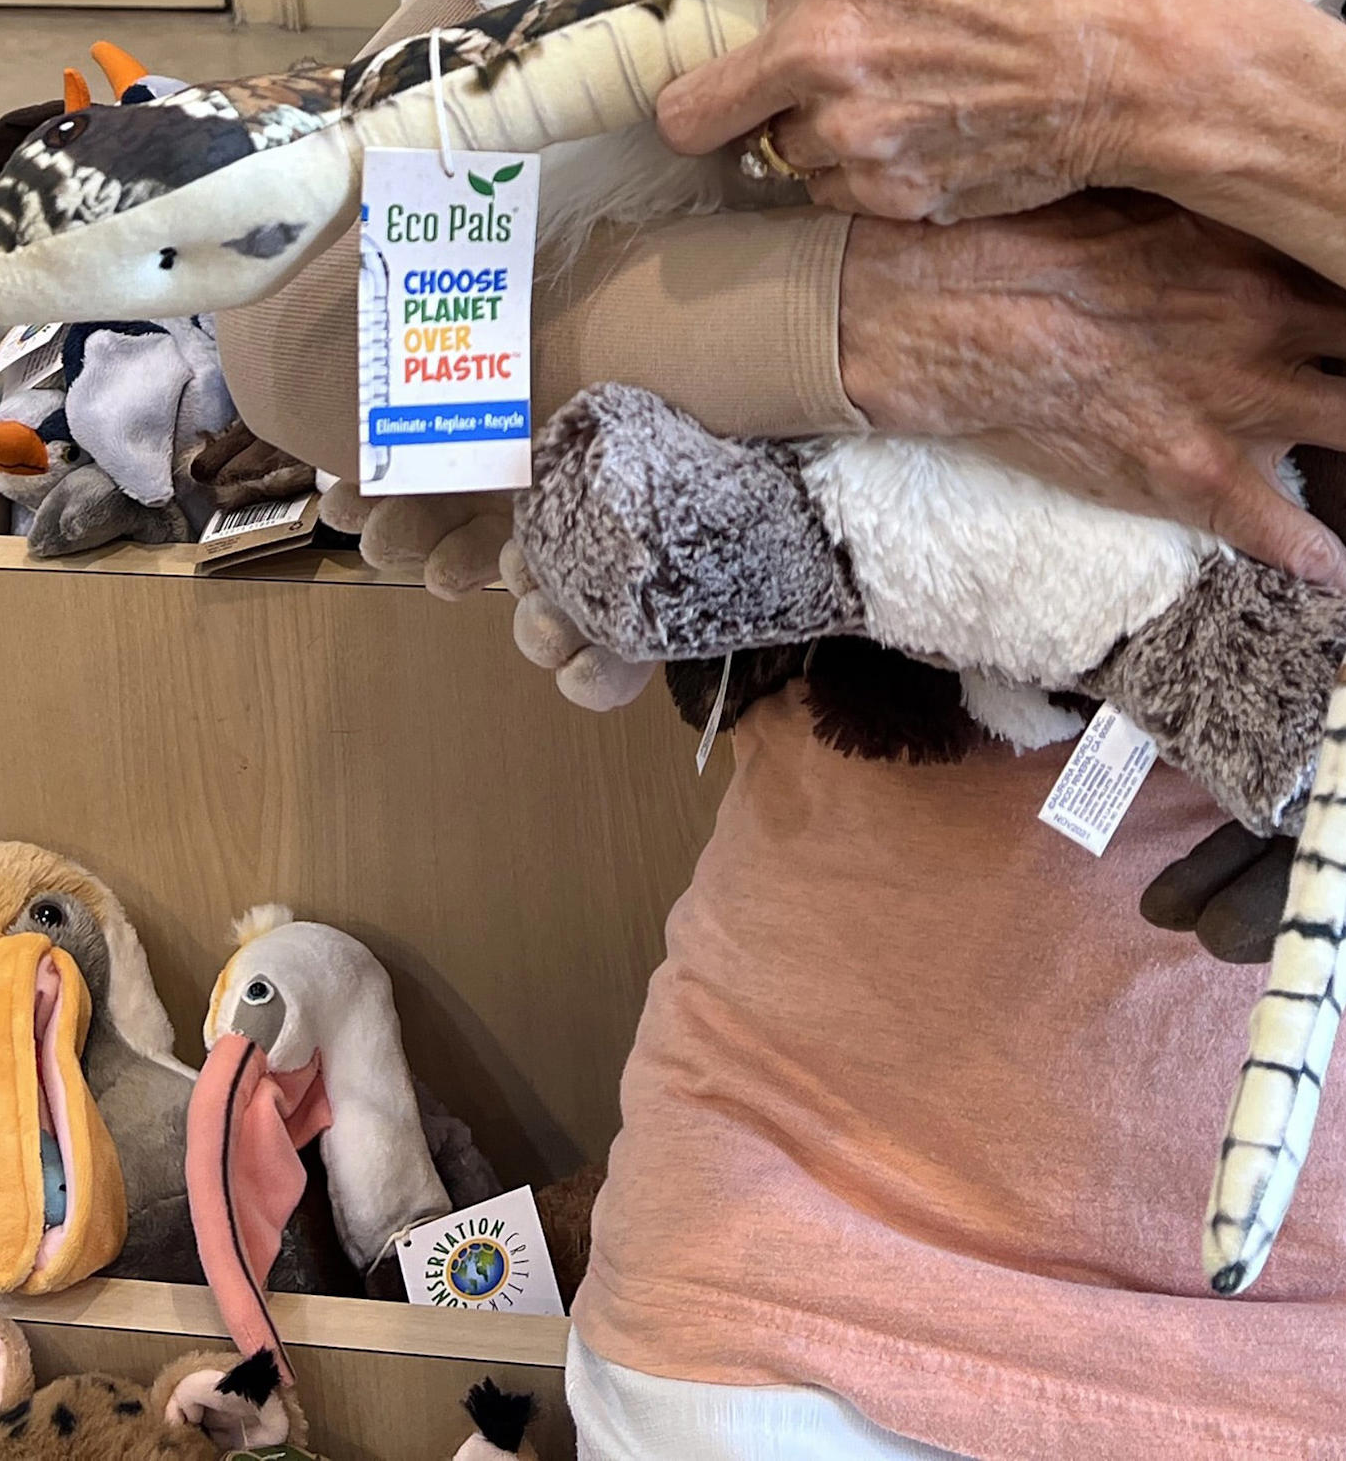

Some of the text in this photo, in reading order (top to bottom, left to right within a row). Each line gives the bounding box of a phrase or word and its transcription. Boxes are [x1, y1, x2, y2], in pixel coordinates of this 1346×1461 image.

[387, 201, 512, 242] Eco Pals
[404, 268, 508, 295] CHOOSE
[404, 296, 503, 324] PLANET
[404, 325, 471, 353] OVER
[404, 353, 512, 383] PLASTIC
[376, 411, 525, 436] Eliminate Replace Recycle
[1091, 741, 1101, 753] CA
[476, 1232, 530, 1312] CRITTER
